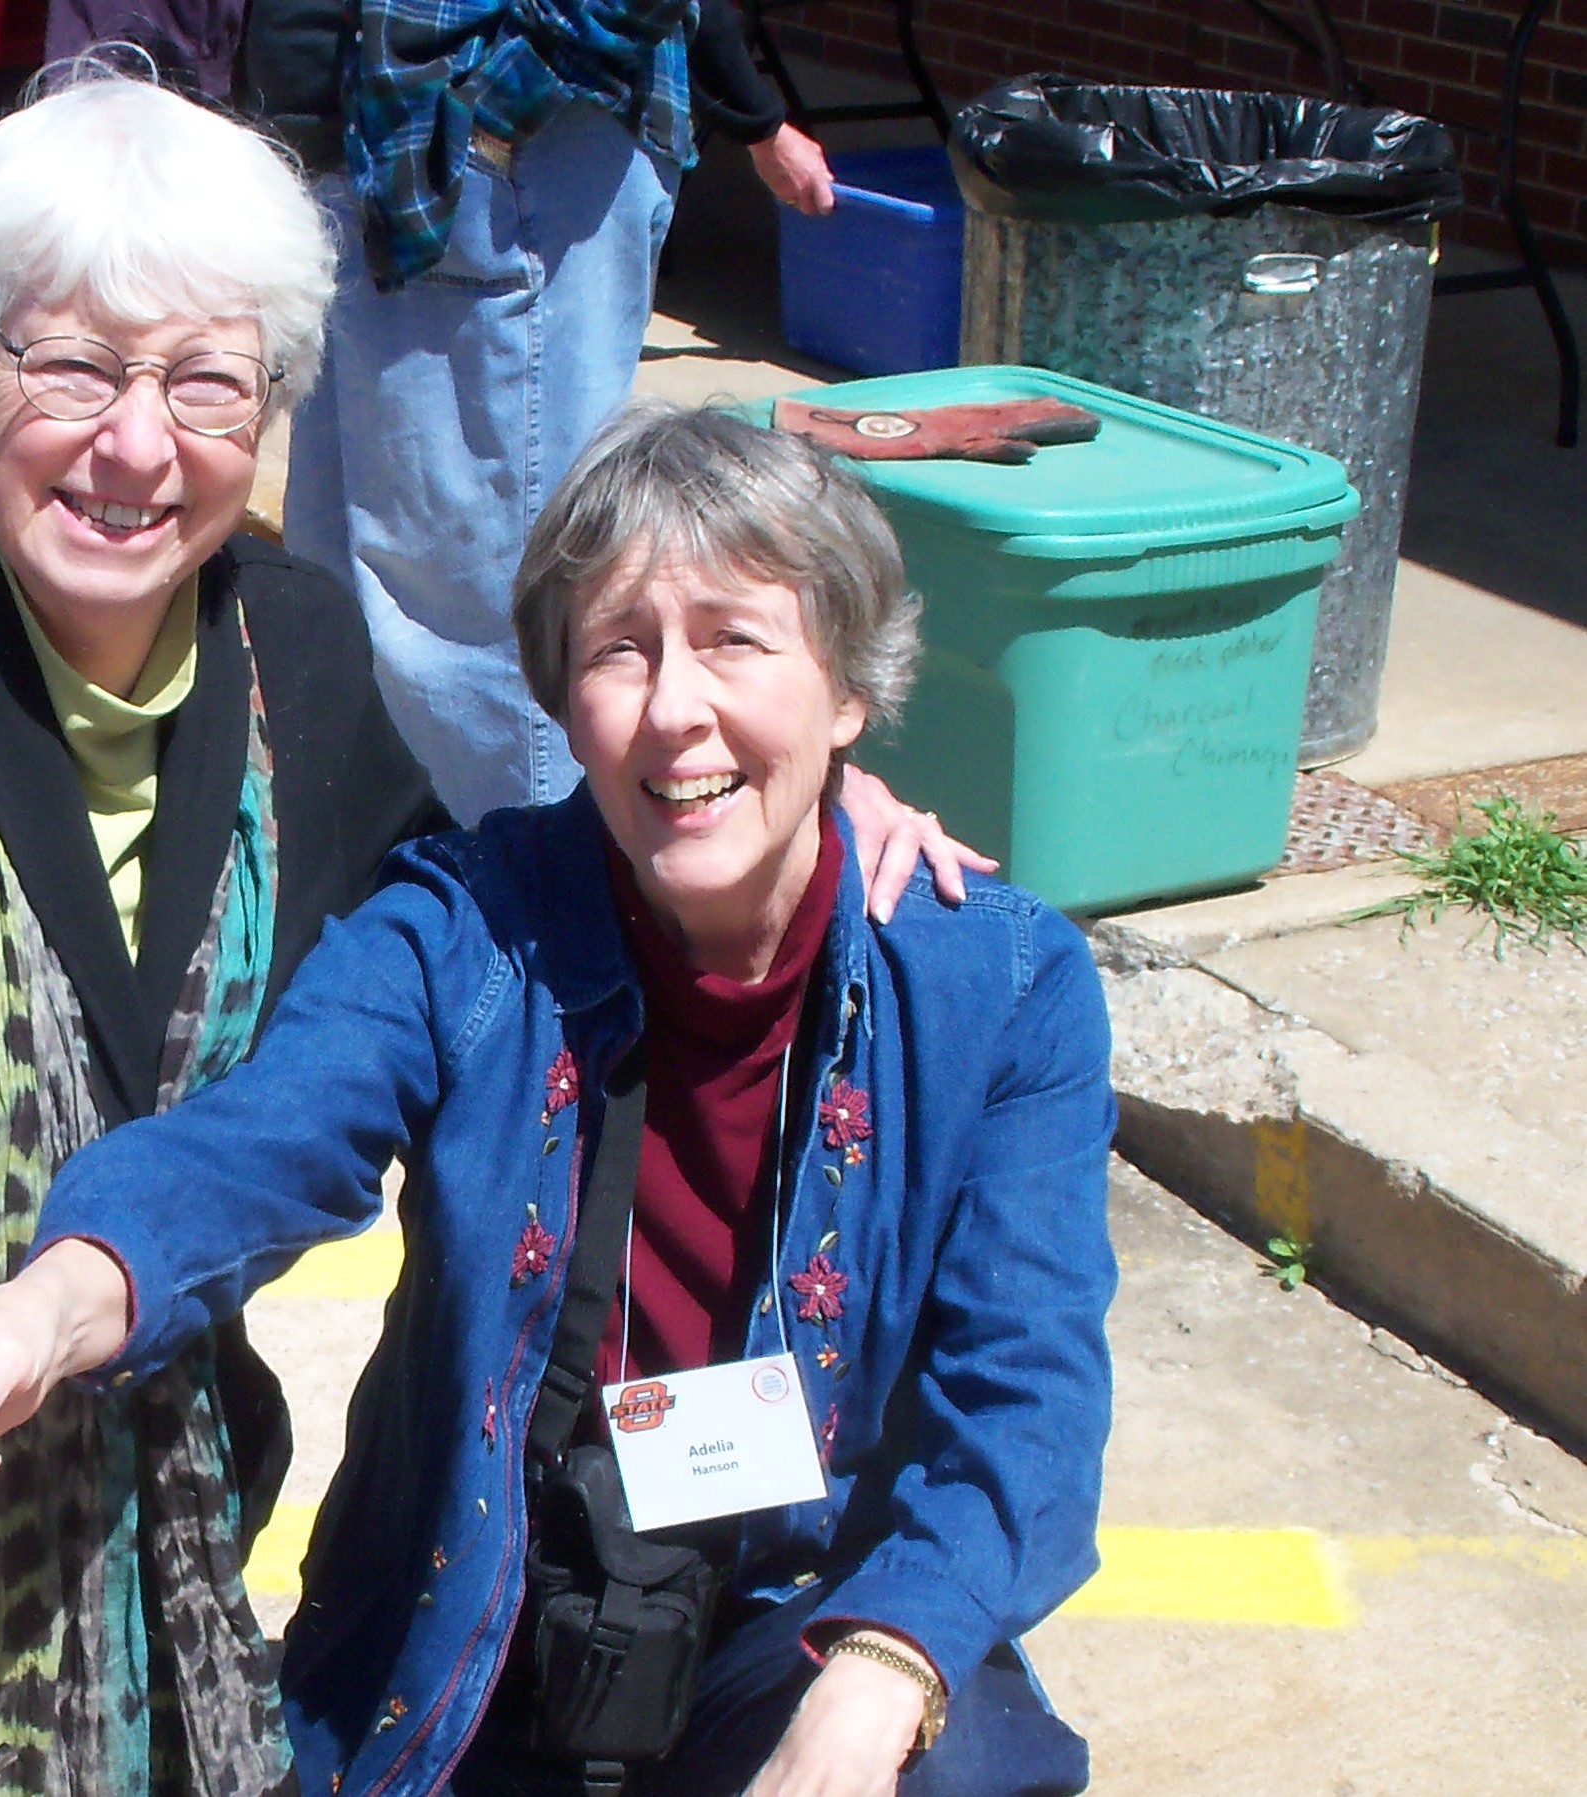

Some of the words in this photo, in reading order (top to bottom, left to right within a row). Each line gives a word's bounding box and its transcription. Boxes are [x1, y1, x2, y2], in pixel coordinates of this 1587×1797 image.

[610, 1395, 676, 1419] STATE
[689, 1440, 735, 1457] Adelia
[692, 1460, 739, 1476] Hanson
